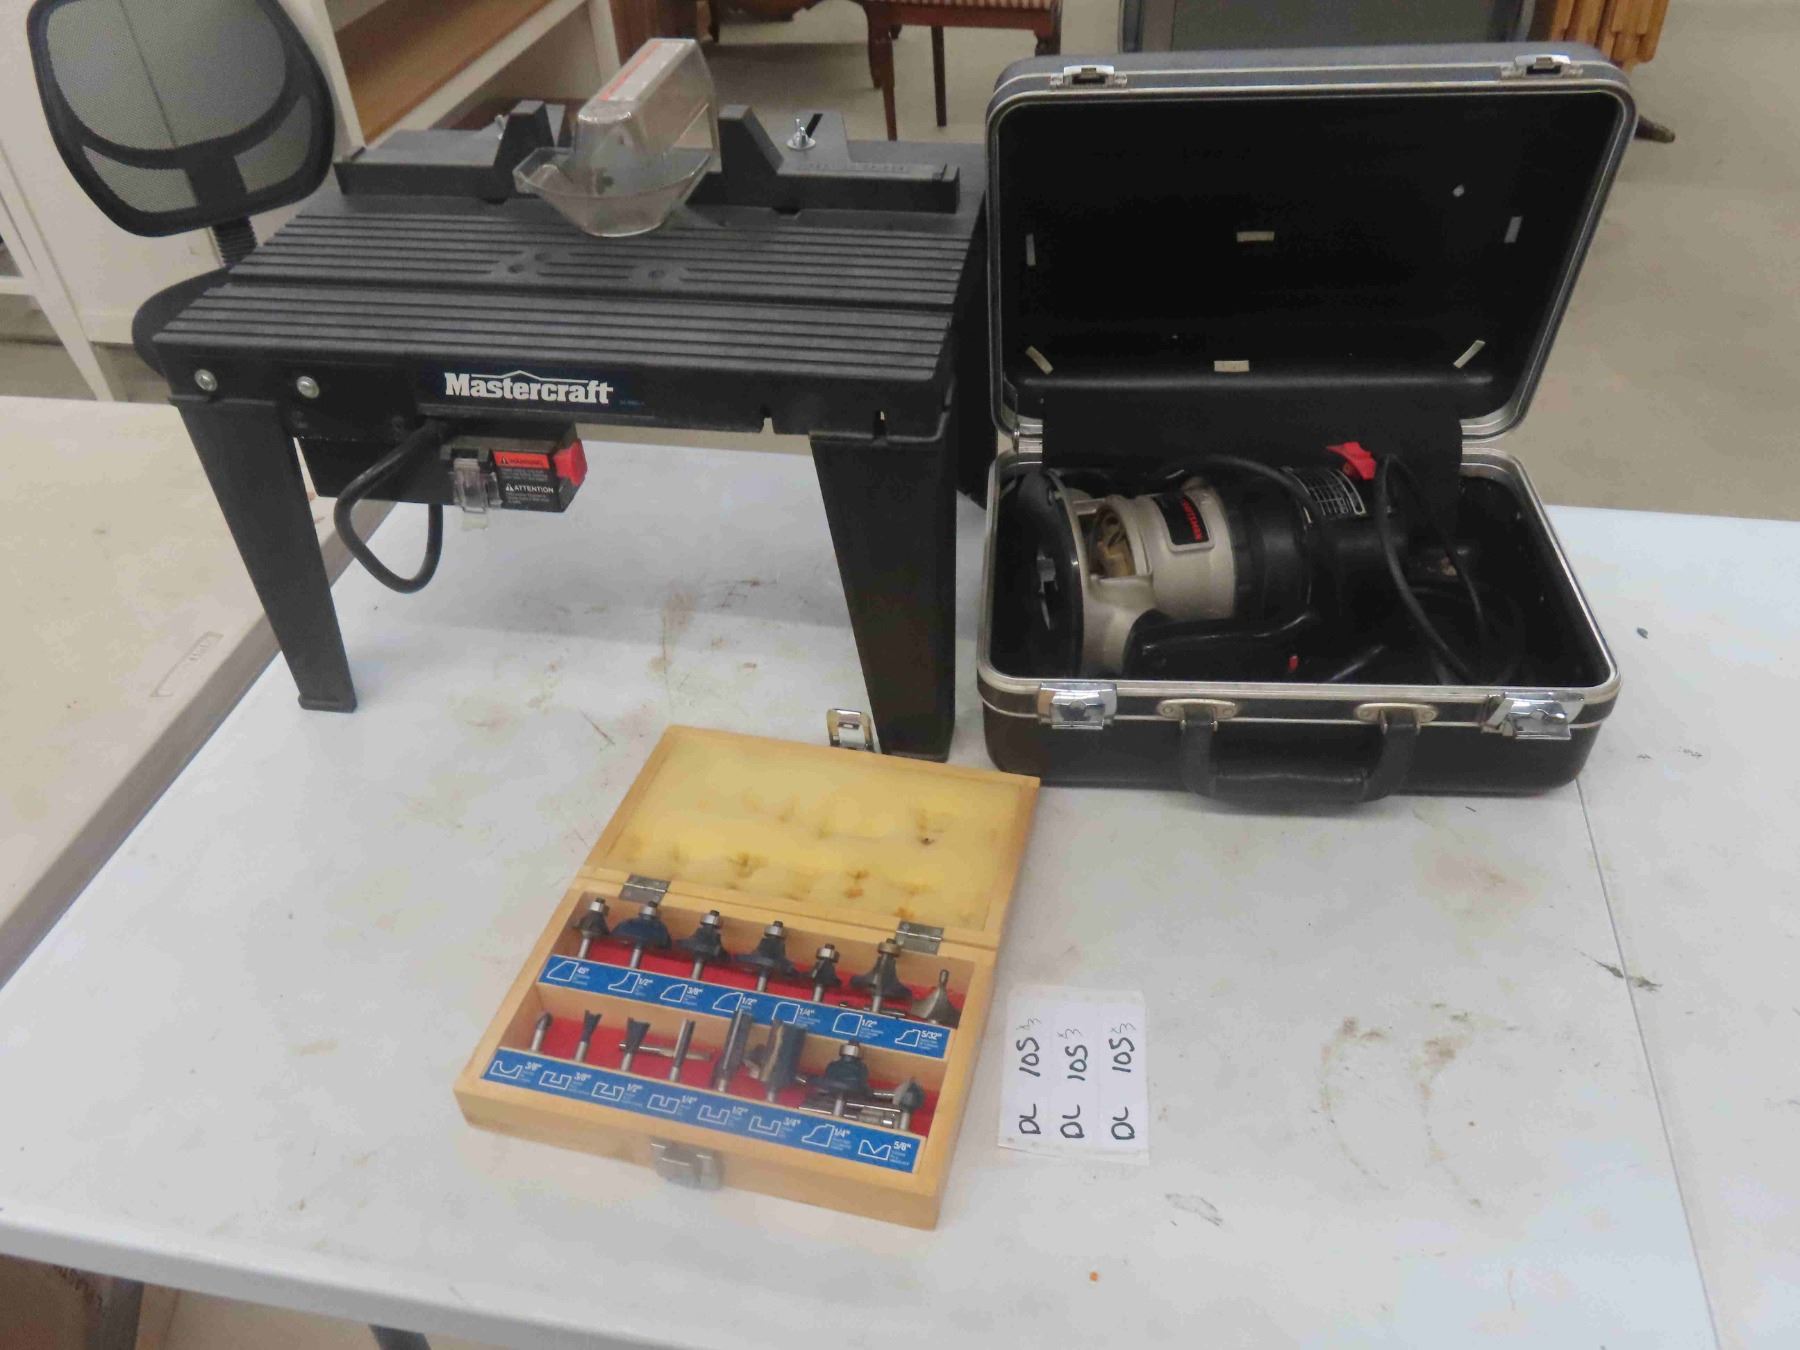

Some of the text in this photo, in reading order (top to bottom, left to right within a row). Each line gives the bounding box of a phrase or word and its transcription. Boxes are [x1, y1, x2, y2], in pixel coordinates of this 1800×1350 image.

[444, 371, 614, 404] Mastercraft
[514, 485, 554, 494] ATTENTION
[638, 977, 654, 986] 1/2"
[686, 986, 703, 995] 3/8"
[741, 997, 757, 1006] 1/2"
[861, 1018, 878, 1028] 1/2"
[920, 1030, 942, 1039] 5/32"
[1016, 1037, 1041, 1077] 105
[1064, 1044, 1088, 1082] 105
[1108, 1037, 1135, 1073] 105
[1018, 1103, 1042, 1135] DL
[1060, 1104, 1085, 1139] DL
[1110, 1106, 1135, 1140] DL
